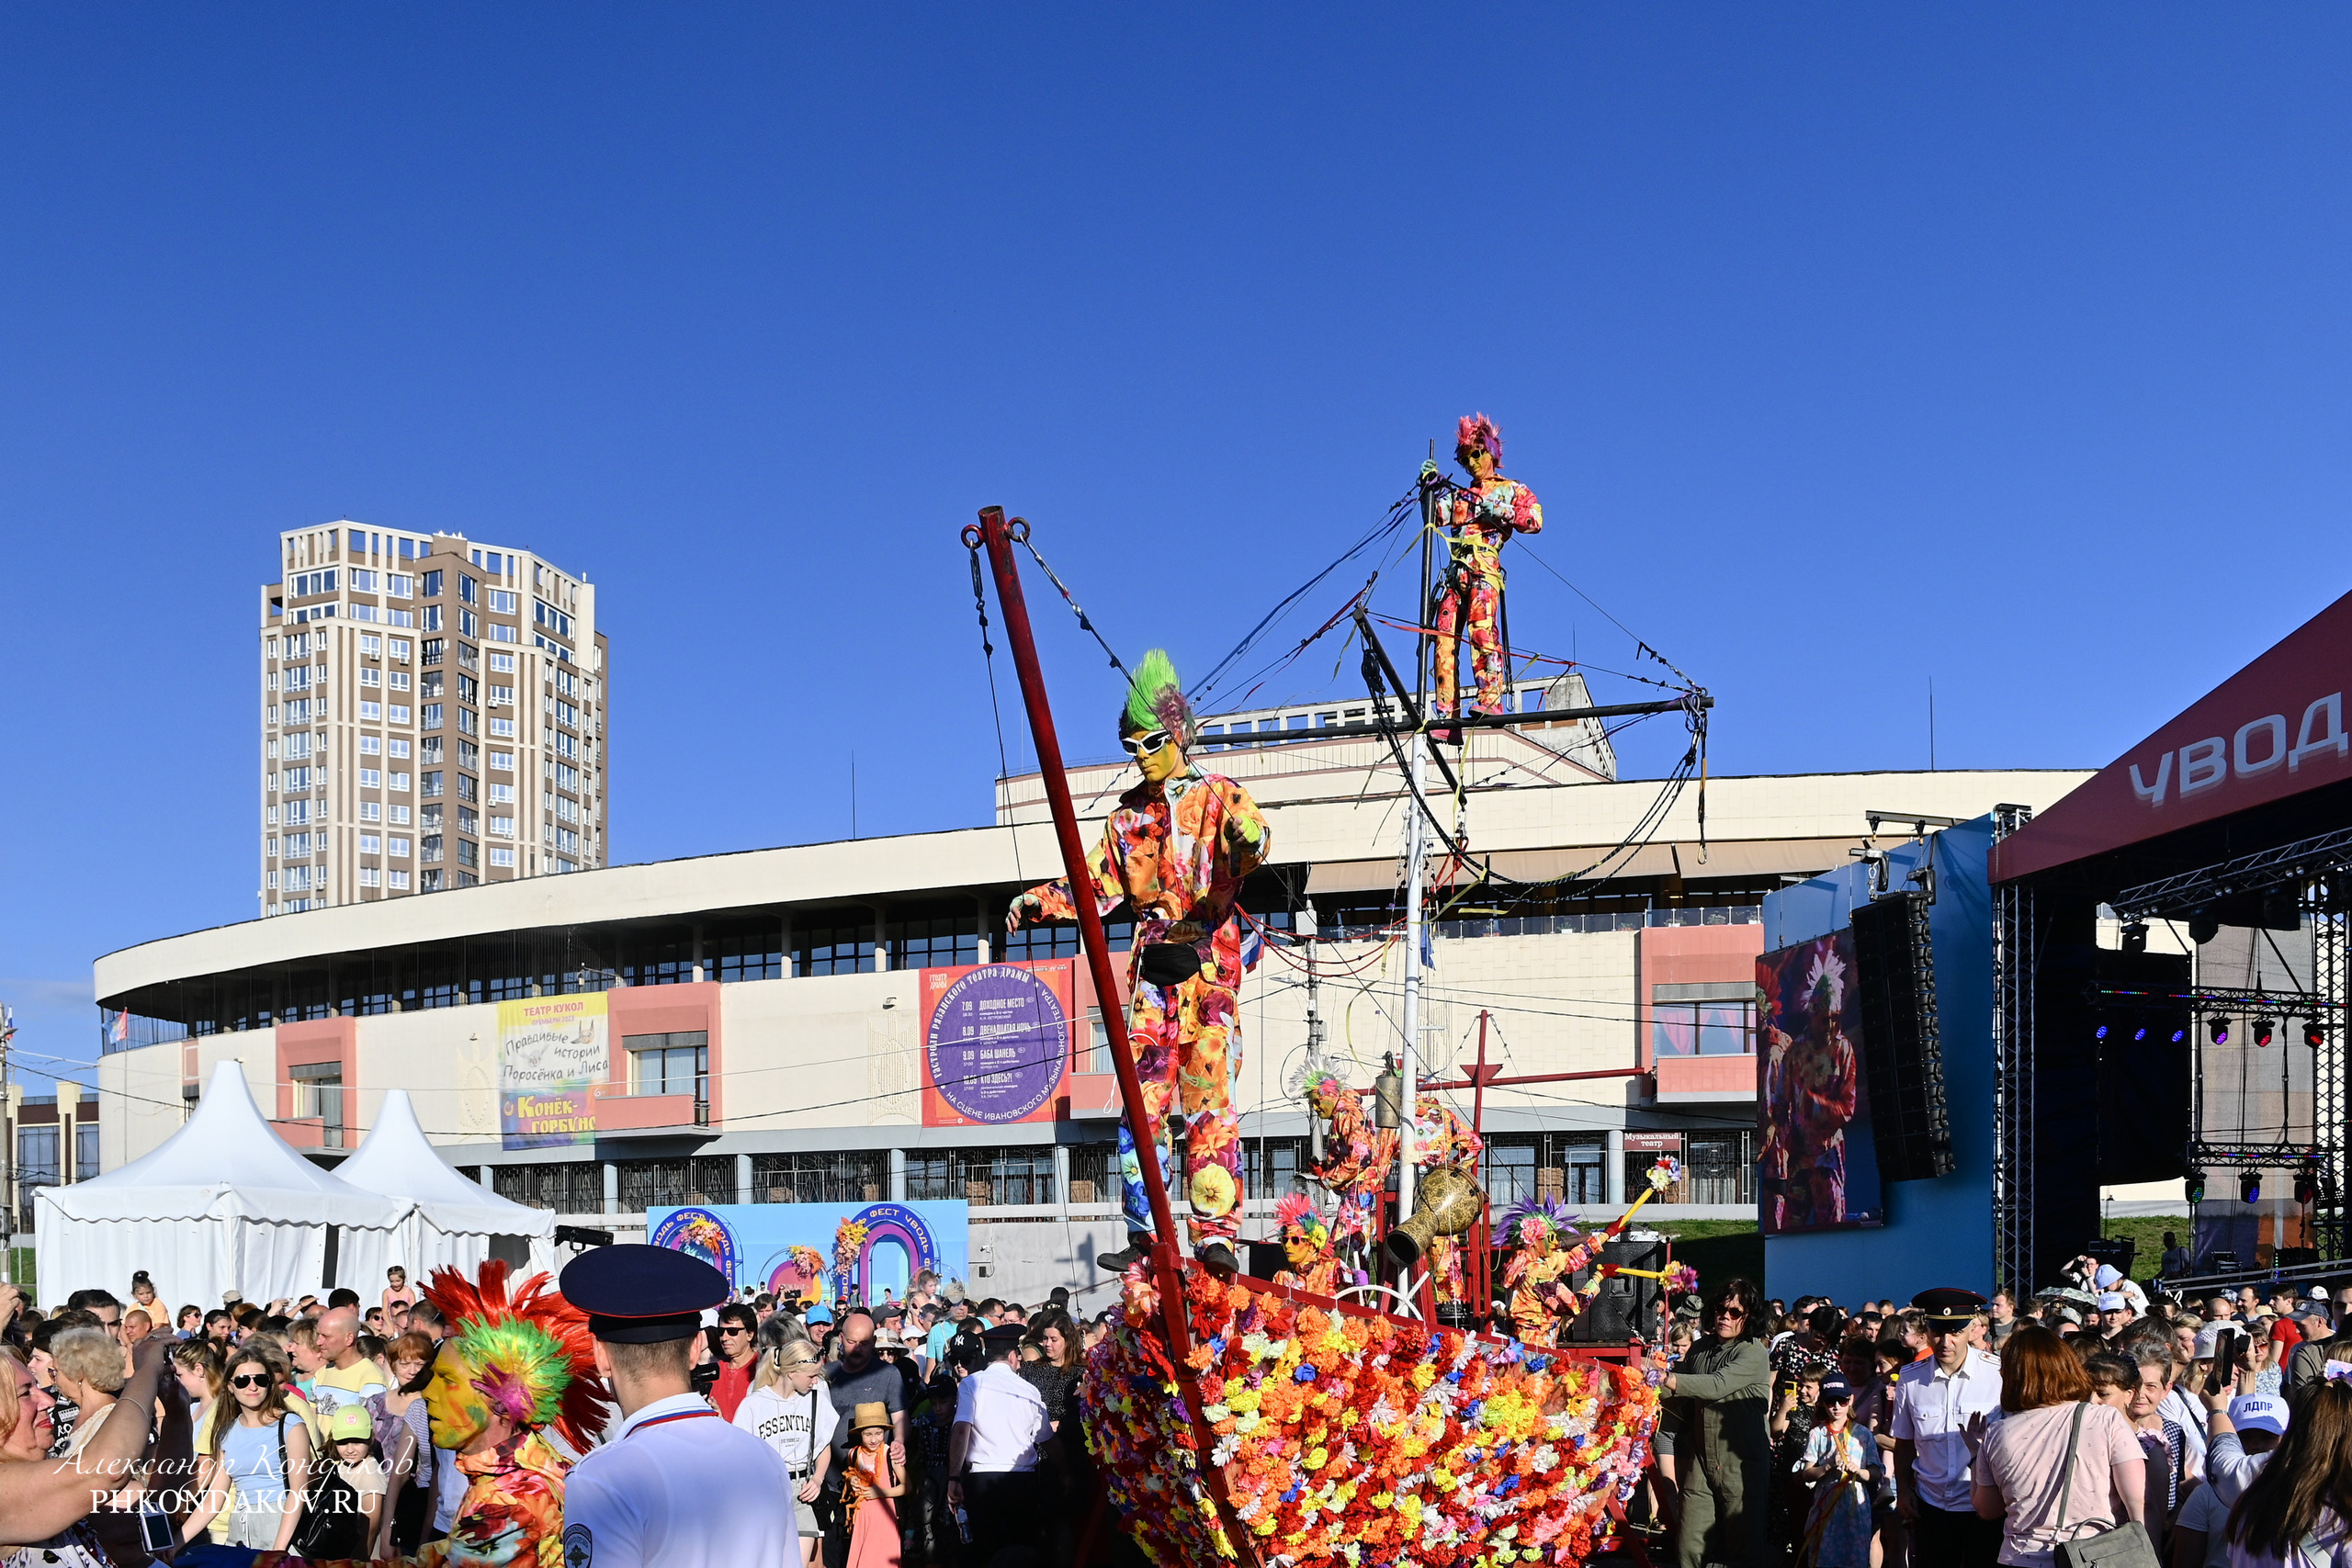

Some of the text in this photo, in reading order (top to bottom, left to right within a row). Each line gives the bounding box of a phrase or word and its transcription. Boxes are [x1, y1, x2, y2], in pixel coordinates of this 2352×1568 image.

[2129, 691, 2349, 807] УВОД
[523, 1002, 584, 1017] ТЕАТР КУКОЛ
[962, 1001, 973, 1011] 7.09
[978, 998, 1007, 1011] ДОХОДНОЕ
[1007, 998, 1025, 1010] МЕСТО
[962, 1026, 975, 1036] 8.09
[505, 1032, 570, 1058] Правдивые
[554, 1044, 601, 1065] истории
[946, 1091, 957, 1105] НА
[956, 1101, 983, 1120] СЦЕНЕ
[984, 1093, 1044, 1121] ИВАНОВСКОГО
[1040, 987, 1061, 1021] ТЕАТРА
[962, 1050, 975, 1061] 9.09
[980, 1049, 994, 1060] БАБА
[994, 1048, 1016, 1059] ШАНЕЛЬ
[503, 1059, 609, 1084] Поросёнка и Лиса
[1623, 1133, 1679, 1142] Музыкальный
[1641, 1140, 1664, 1148] театр
[869, 1207, 930, 1254] ФЕСТ УВОДЬ
[2243, 1401, 2273, 1413] ЛДПР
